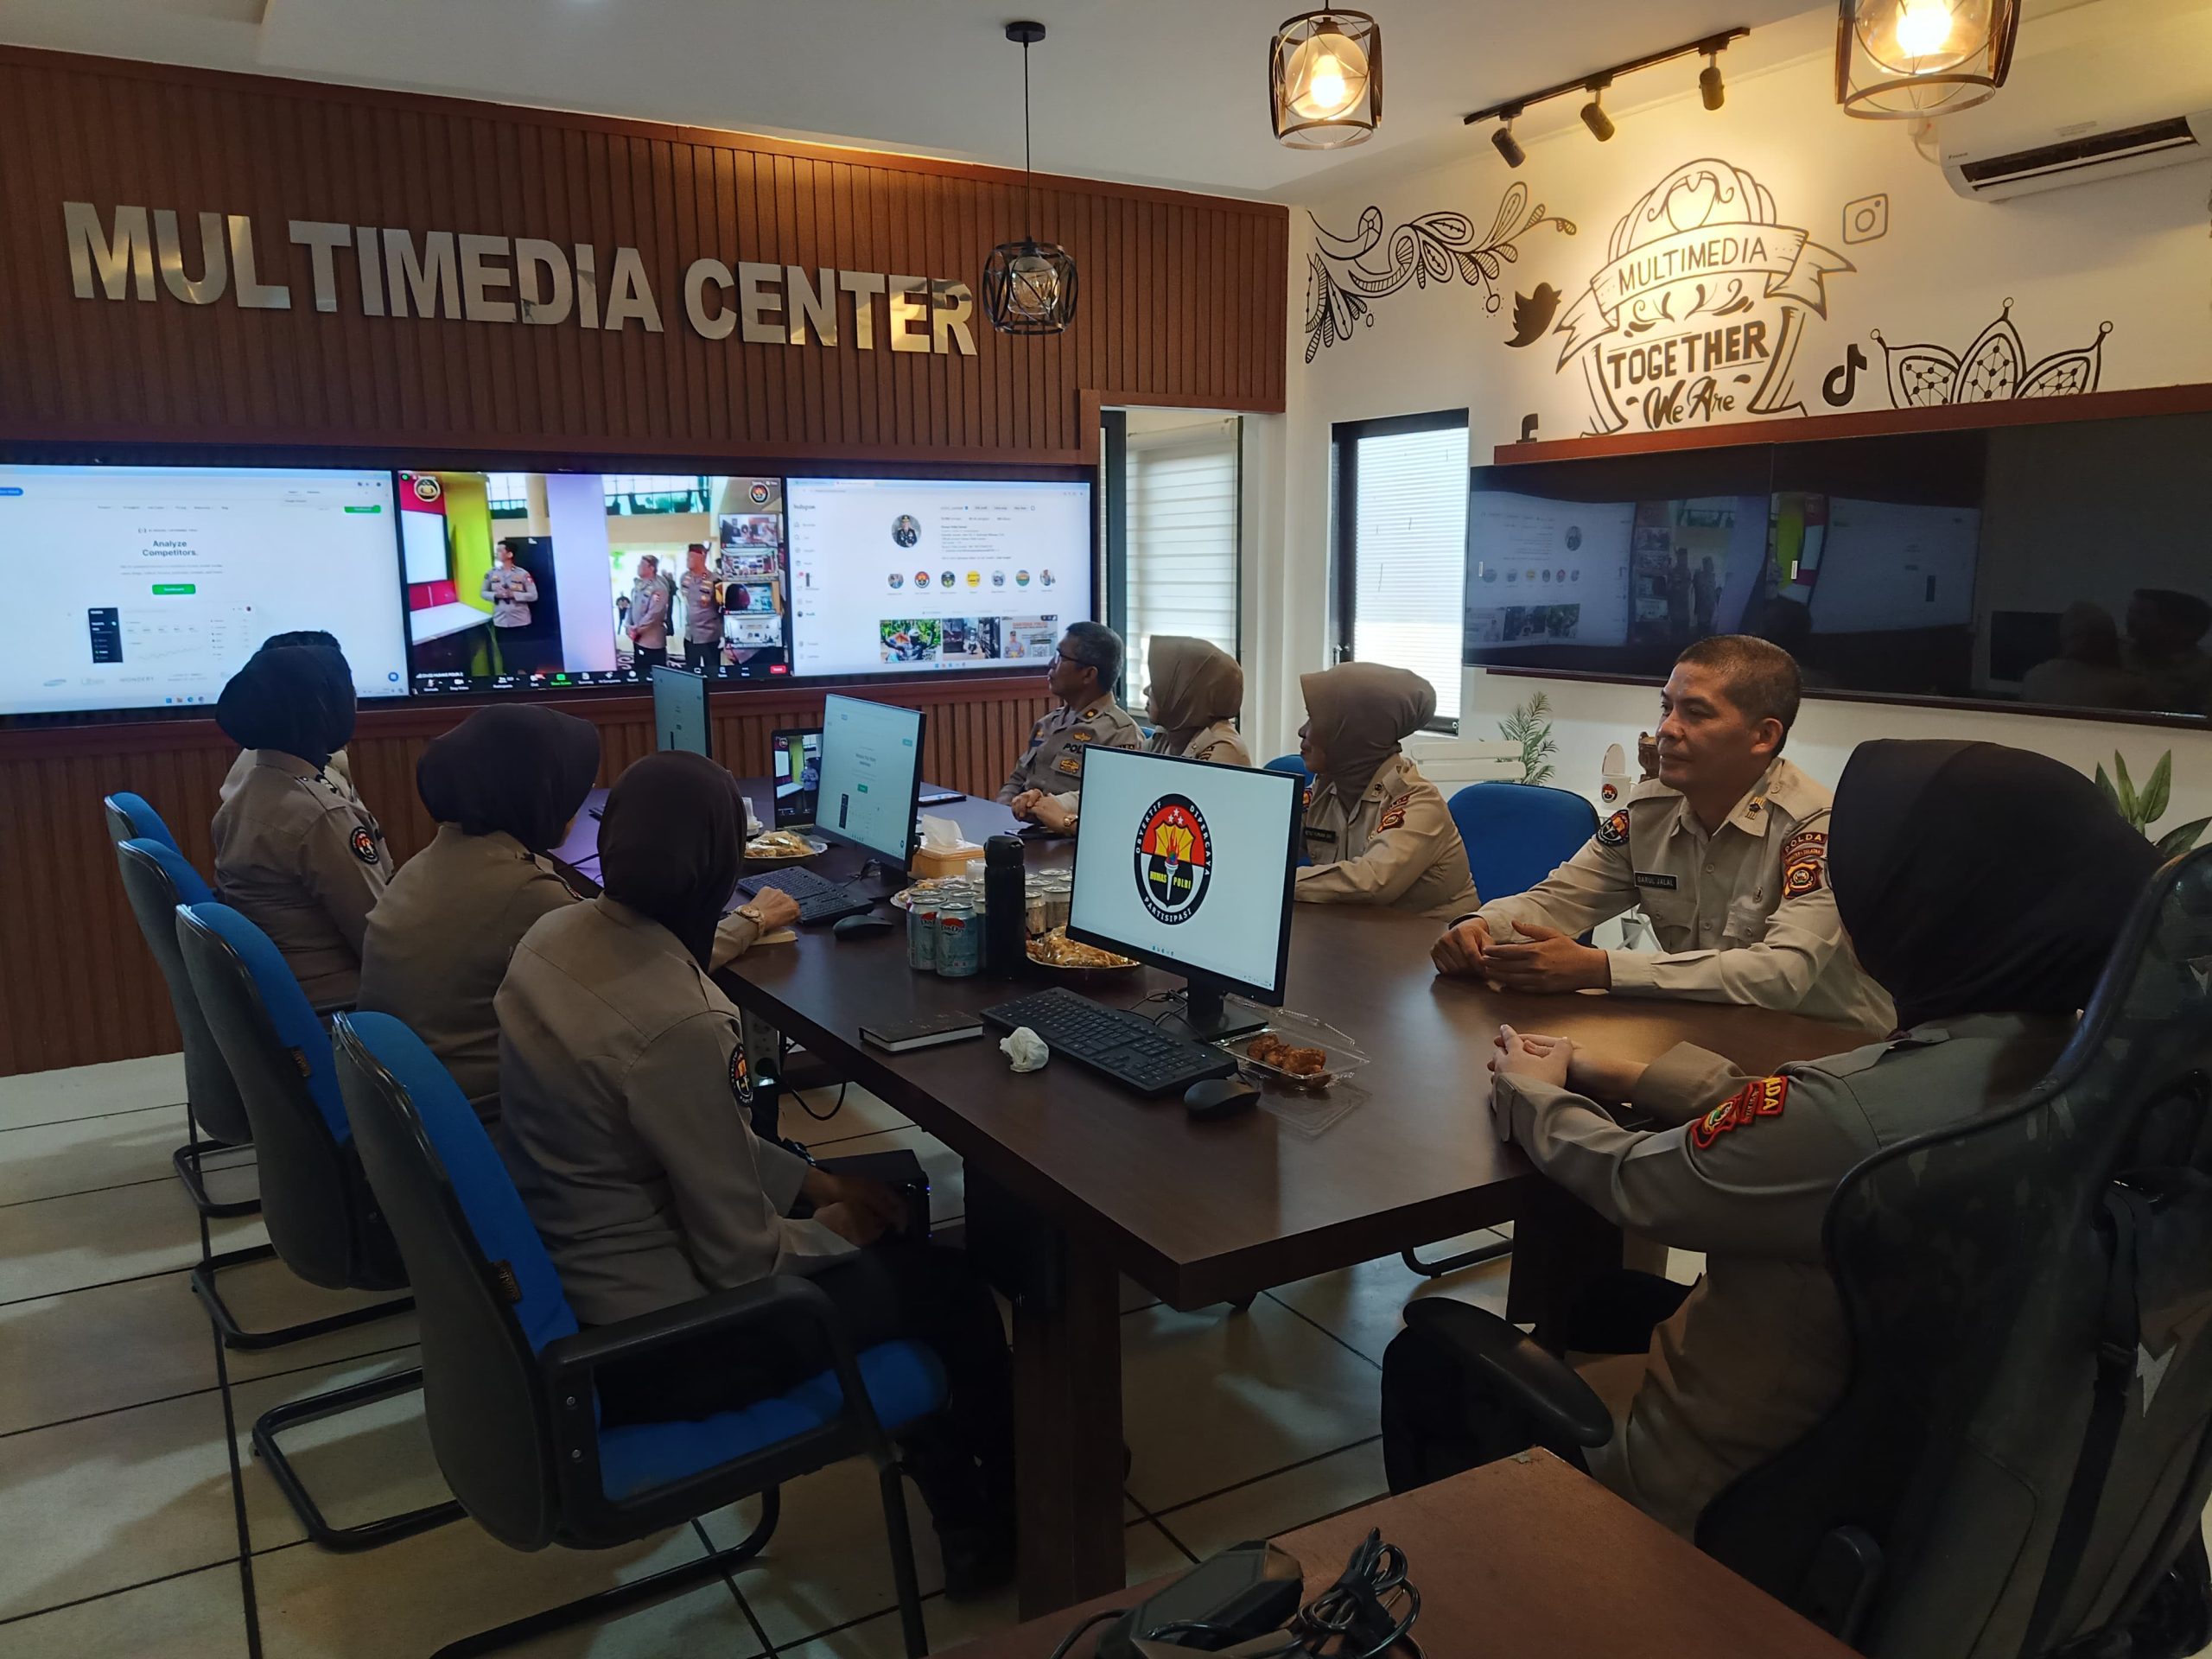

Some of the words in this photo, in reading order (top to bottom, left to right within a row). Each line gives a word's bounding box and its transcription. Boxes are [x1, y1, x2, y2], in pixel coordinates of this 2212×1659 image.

[63, 201, 664, 333] MULTIMEDIA
[684, 258, 977, 355] CENTER
[1618, 237, 1768, 296] MULTIMEDIA
[1606, 320, 1770, 390] TOGETHER
[1643, 378, 1686, 430] We
[1687, 375, 1735, 423] Are
[1063, 743, 1082, 753] POL
[1135, 801, 1162, 854] OBYEKTIF
[1189, 804, 1211, 876] DIPERCAYA
[1784, 834, 1821, 853] POLDA
[1149, 870, 1166, 883] HUMAS
[1173, 876, 1191, 889] POLRI
[1144, 896, 1192, 922] PARTISIPASI
